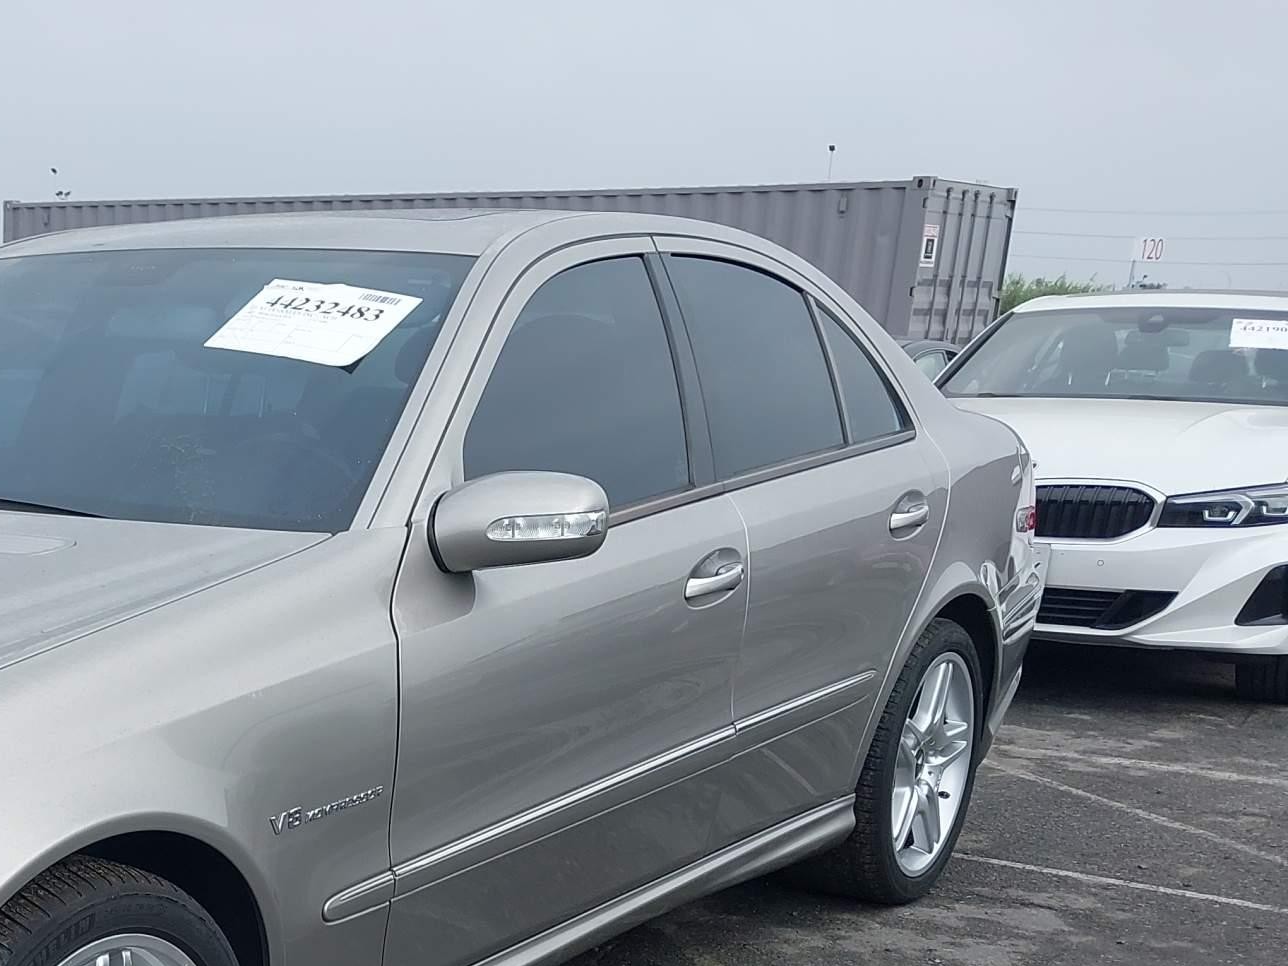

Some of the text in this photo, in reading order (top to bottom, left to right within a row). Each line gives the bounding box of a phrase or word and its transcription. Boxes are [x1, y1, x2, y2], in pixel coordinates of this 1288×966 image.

[1141, 238, 1165, 260] 120
[265, 295, 385, 322] 44232483
[269, 805, 303, 836] V8
